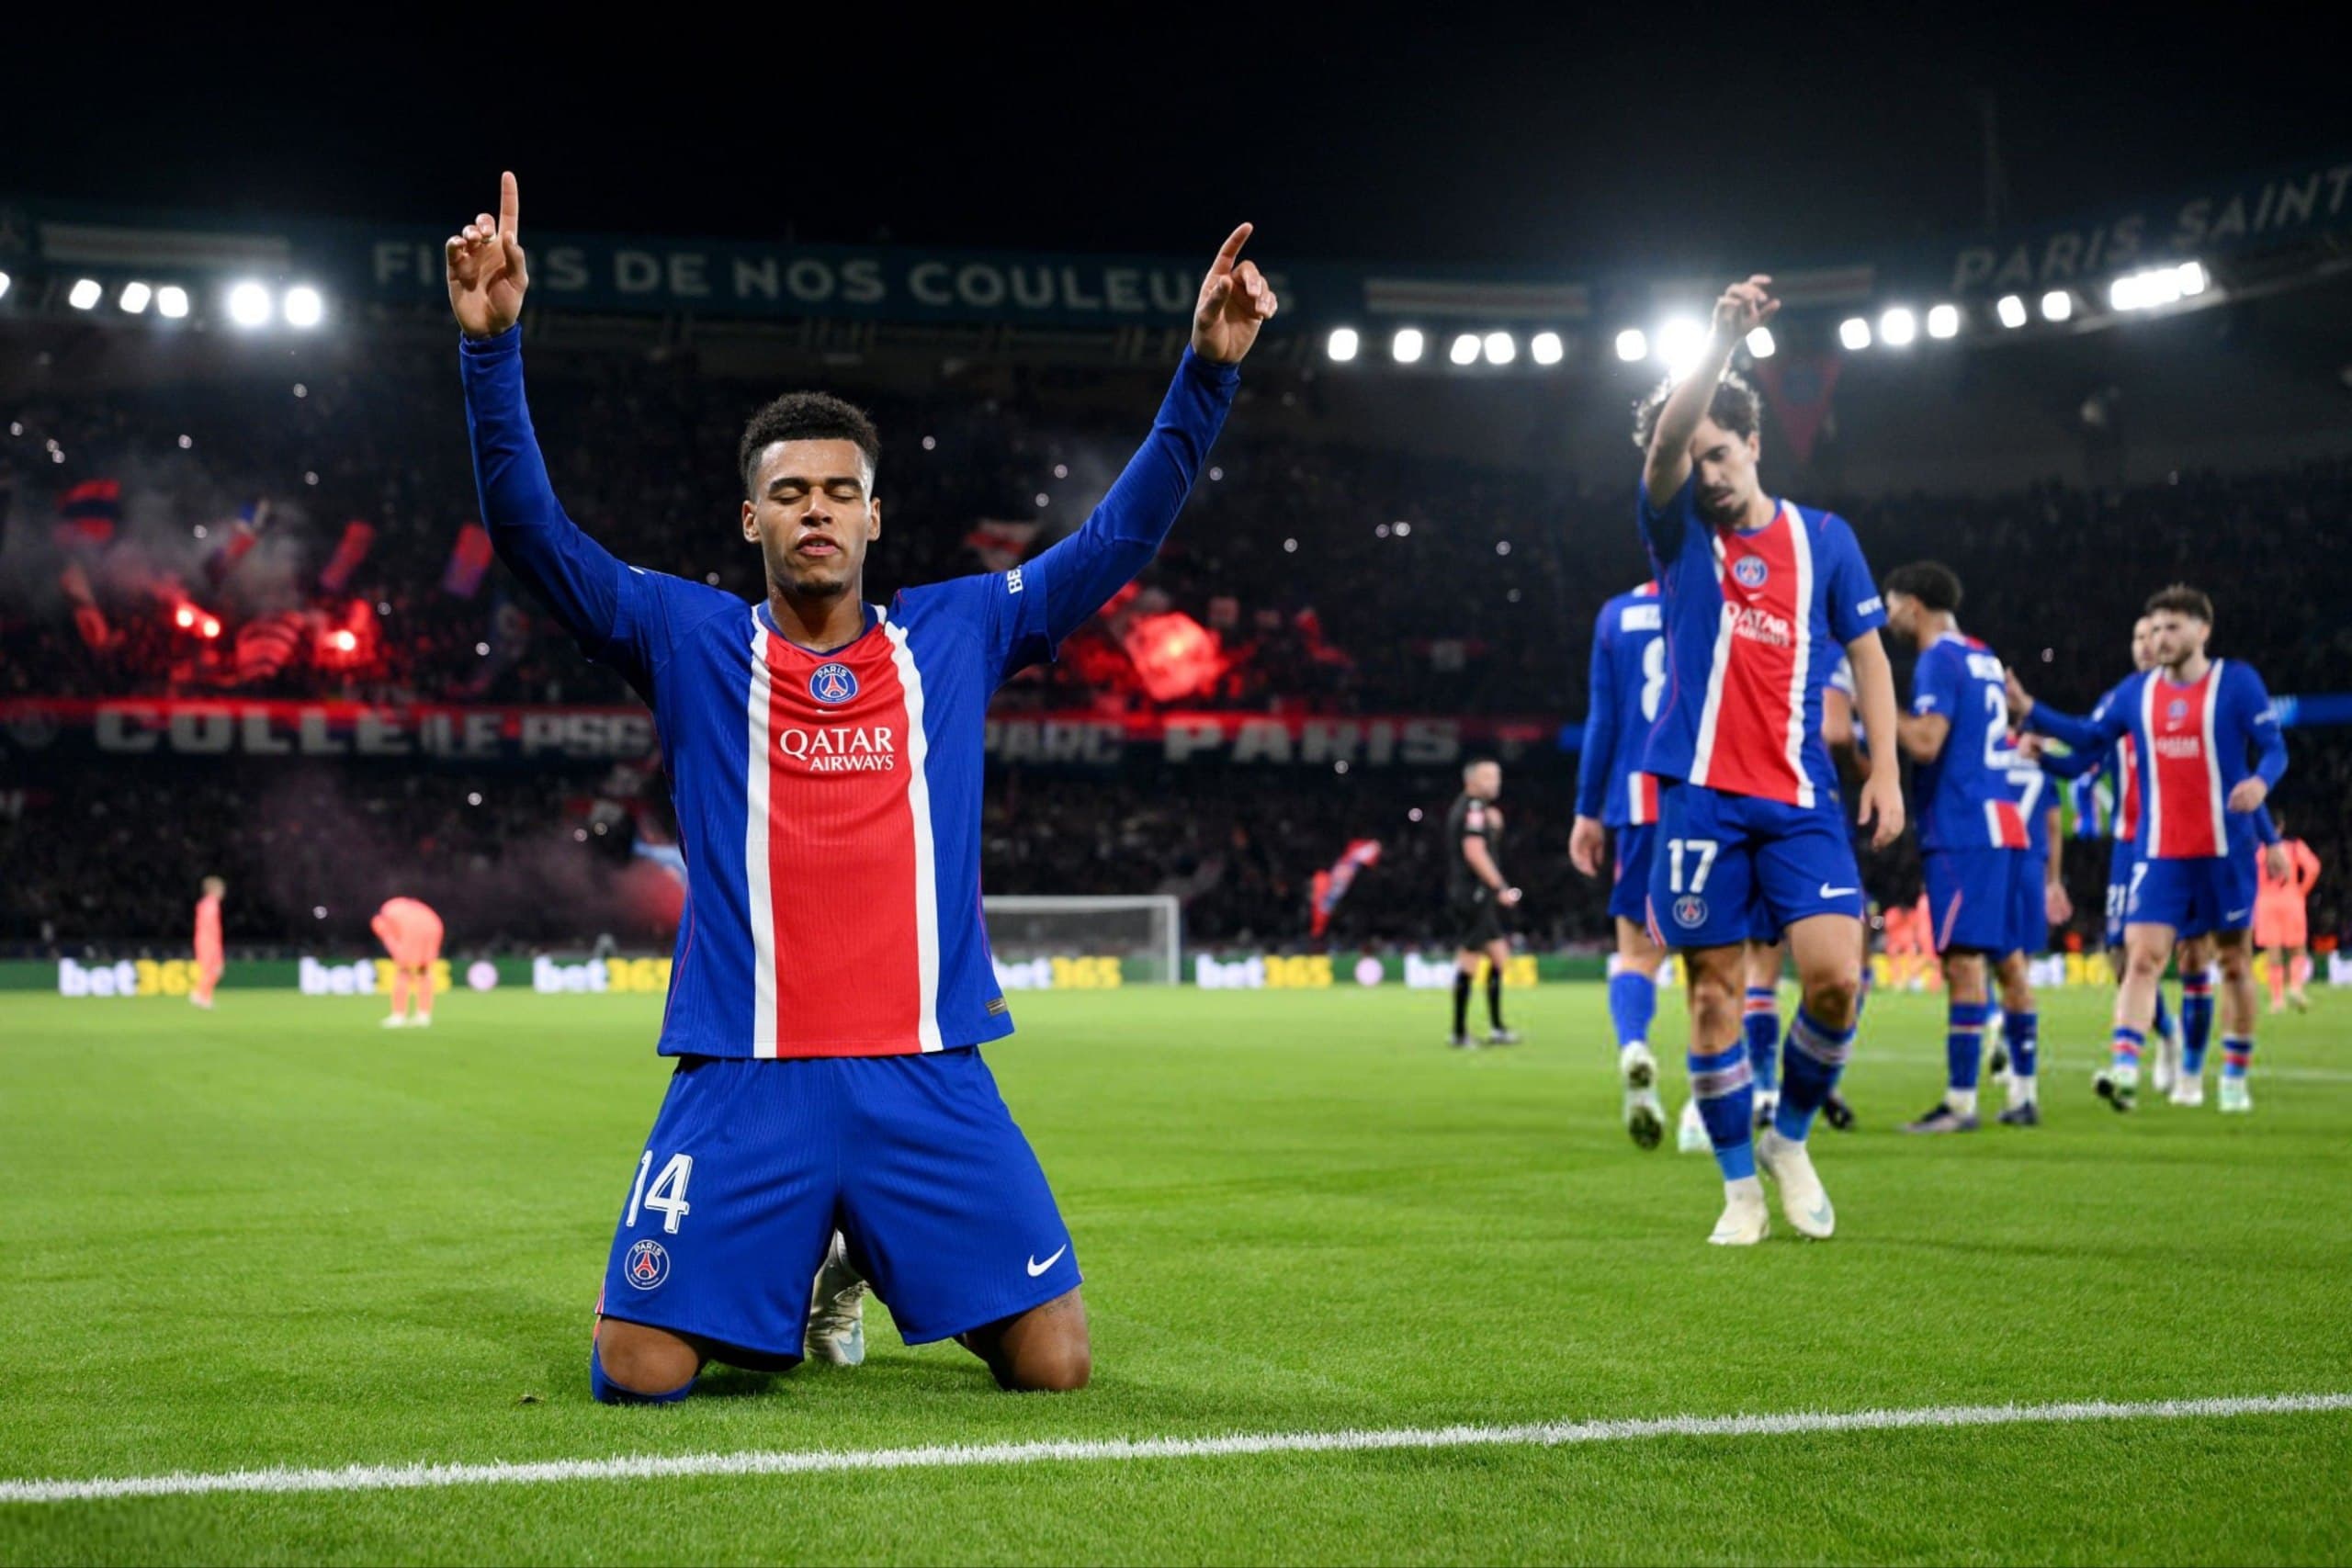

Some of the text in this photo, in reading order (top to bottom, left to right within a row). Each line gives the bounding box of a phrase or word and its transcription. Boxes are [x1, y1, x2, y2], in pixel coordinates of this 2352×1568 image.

[613, 251, 710, 296] DE
[735, 256, 886, 302] NOS
[817, 665, 847, 678] PARIS
[780, 728, 894, 761] QATAR
[1160, 716, 1461, 766] PARIS
[809, 754, 894, 772] AIRWAYS
[1668, 838, 1718, 894] 17
[627, 1150, 694, 1235] 14
[634, 1242, 662, 1257] PARIS
